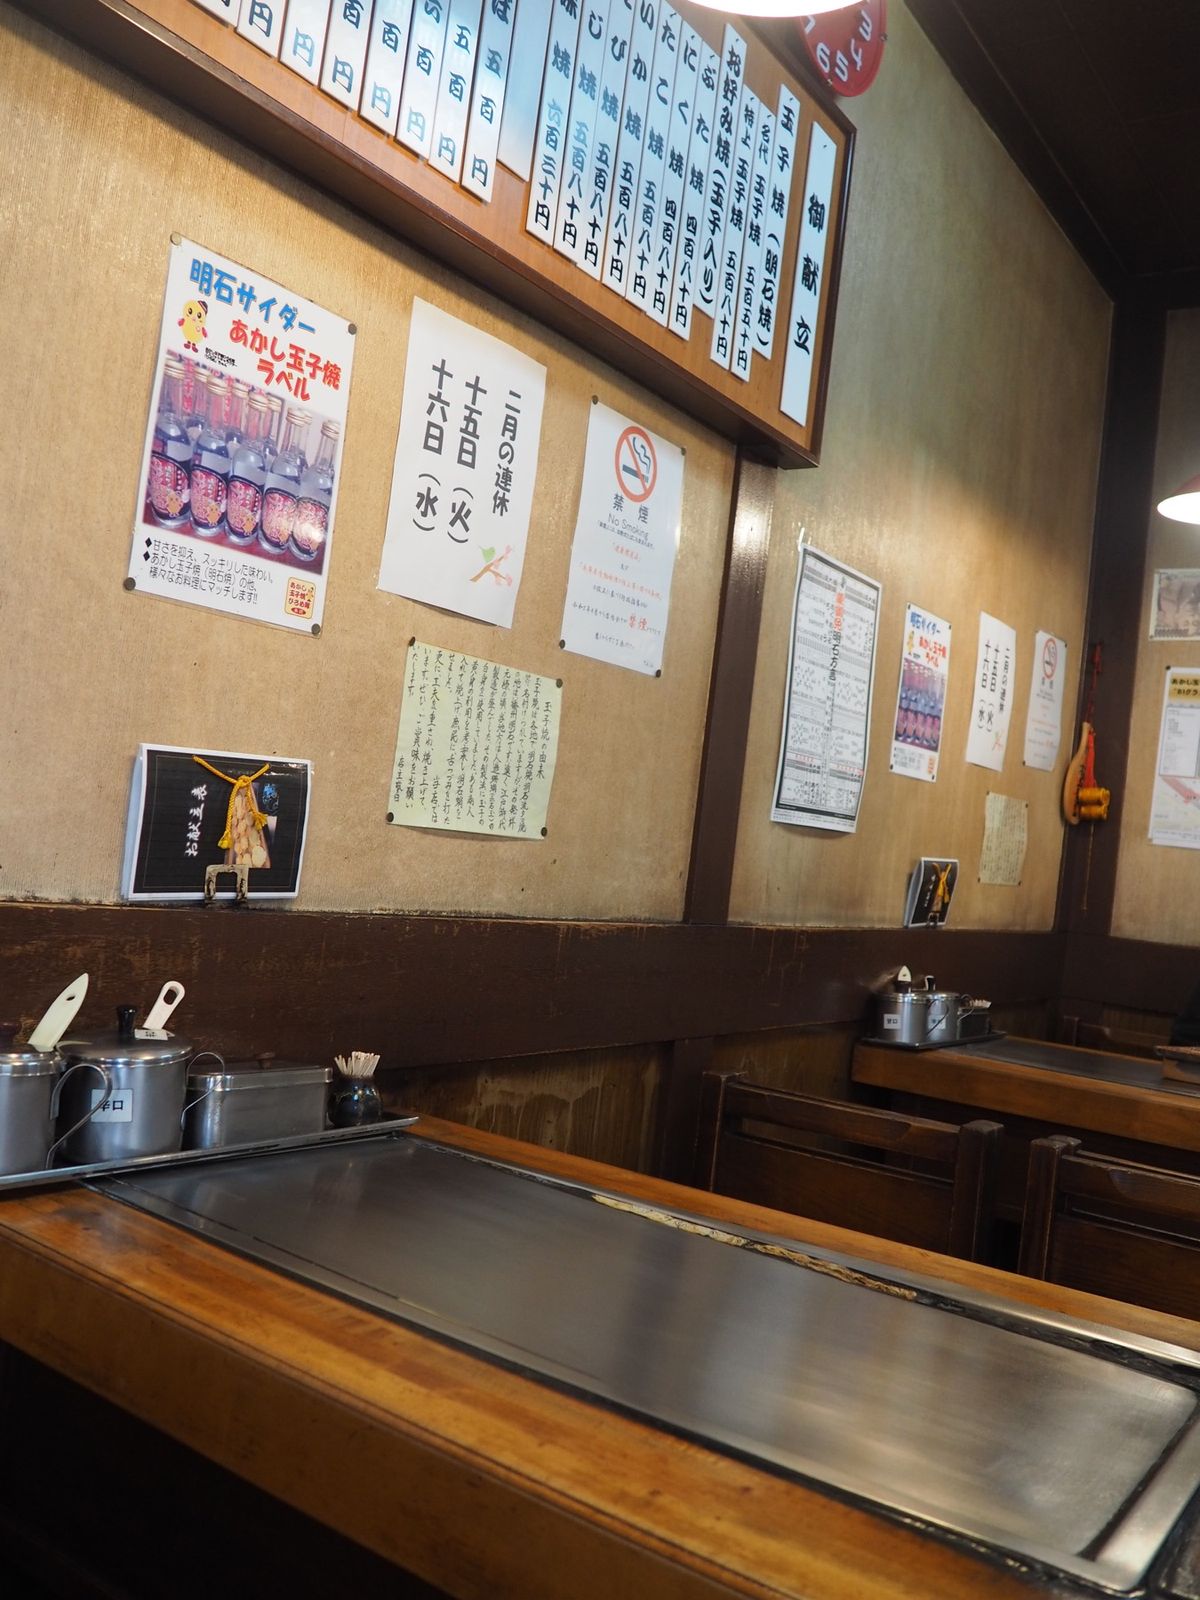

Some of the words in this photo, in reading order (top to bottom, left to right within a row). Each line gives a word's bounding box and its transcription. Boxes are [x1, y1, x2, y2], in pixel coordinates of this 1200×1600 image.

[292, 27, 315, 68] 円
[563, 120, 589, 250] 五百八十円
[584, 142, 611, 268] 五百八十円
[610, 160, 635, 283] 五百八十円
[633, 179, 657, 299] 五百八十円
[189, 257, 317, 334] 明石サイダー
[653, 196, 677, 315] 四百八十円
[675, 213, 698, 329] 四百八十円
[716, 250, 737, 359] 五百八十円
[229, 318, 342, 391] あかし玉子焼
[737, 266, 755, 371] 五百五十円
[257, 357, 311, 402] ラベル
[492, 389, 522, 518] 二月の連休
[608, 512, 620, 527] No
[621, 518, 649, 542] Smoking
